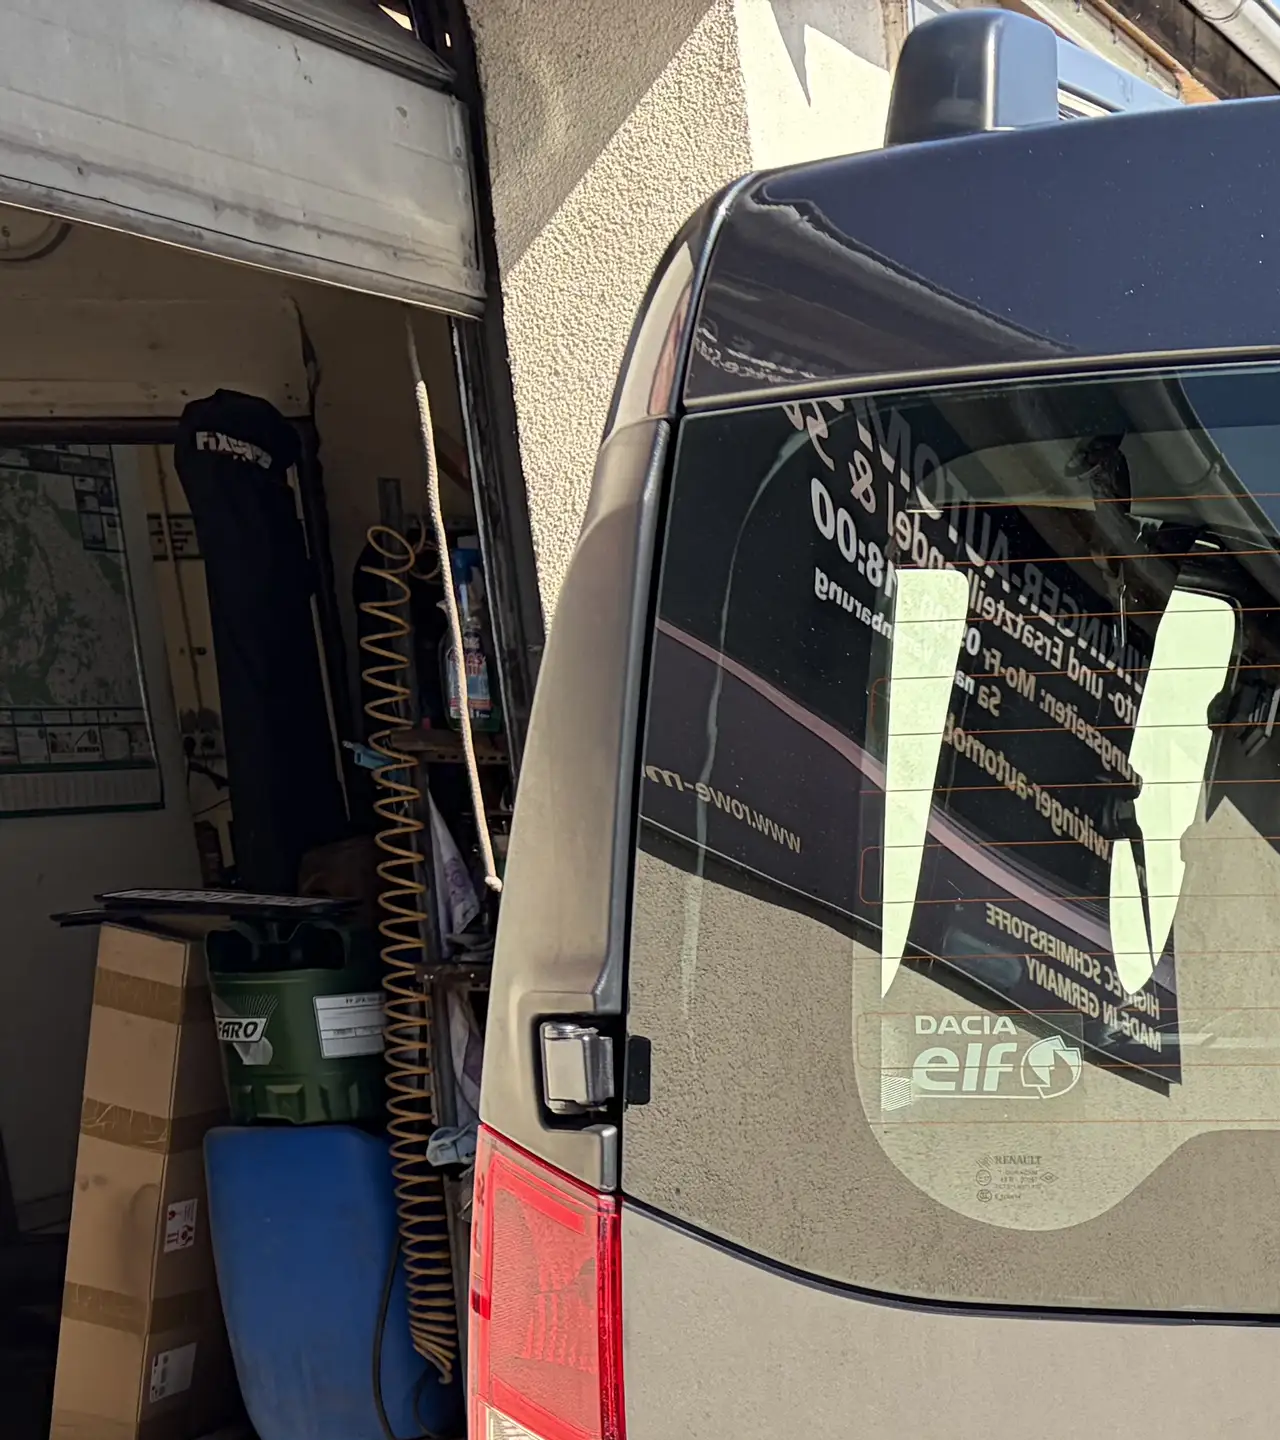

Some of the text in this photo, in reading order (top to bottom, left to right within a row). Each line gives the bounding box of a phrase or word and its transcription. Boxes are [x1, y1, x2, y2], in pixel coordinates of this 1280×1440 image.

[915, 1015, 1018, 1036] DACIA
[912, 1042, 1018, 1092] elf
[994, 1155, 1043, 1166] RENAULT
